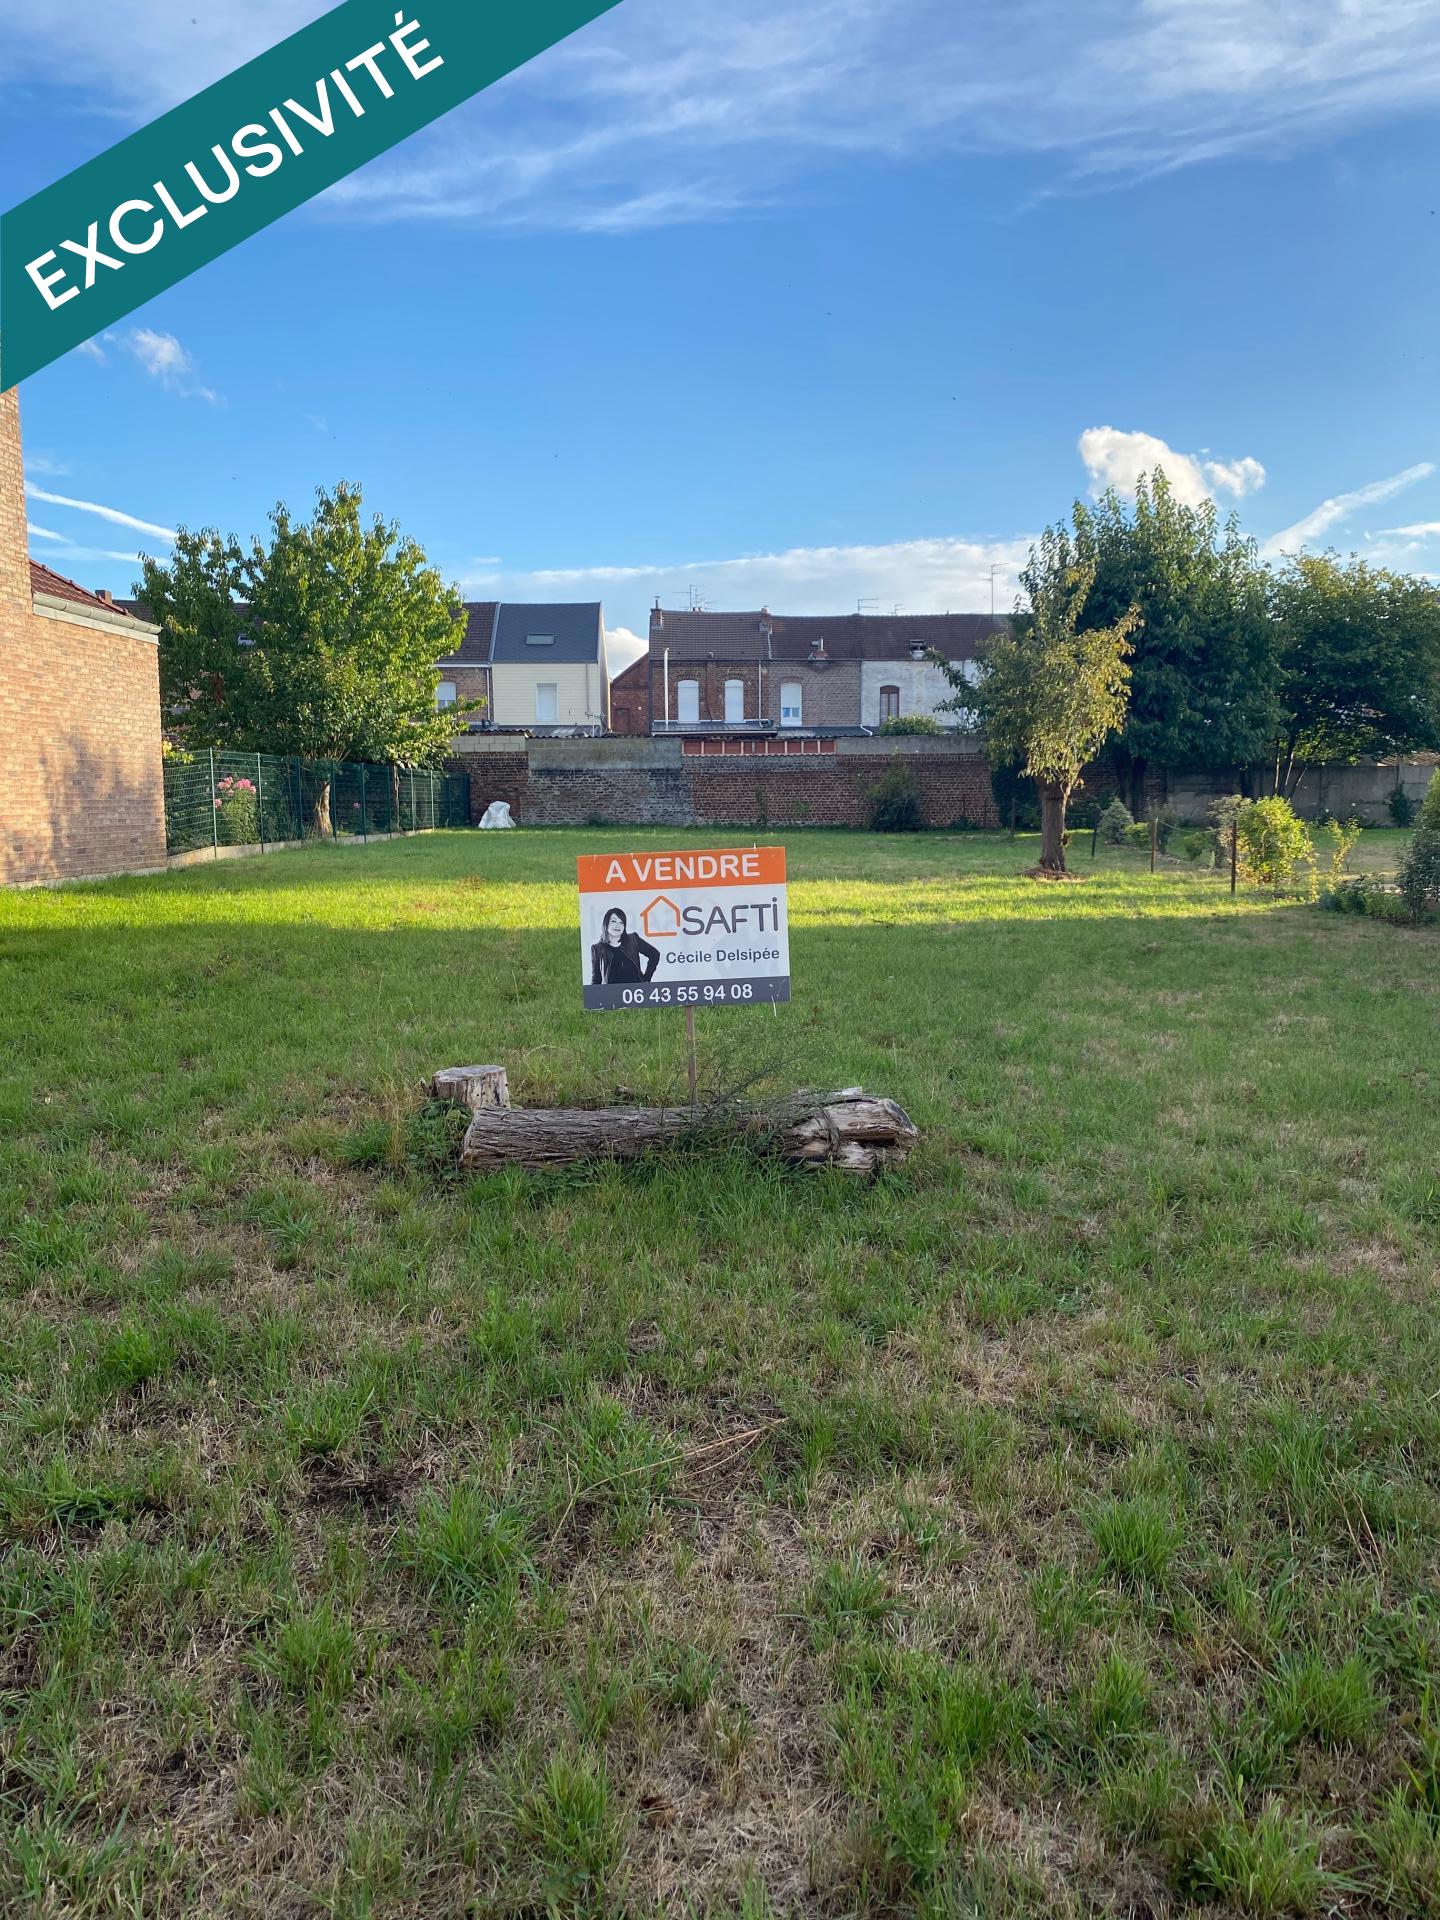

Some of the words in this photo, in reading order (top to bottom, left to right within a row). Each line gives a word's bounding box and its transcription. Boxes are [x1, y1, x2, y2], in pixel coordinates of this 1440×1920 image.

[605, 859, 627, 884] A
[632, 853, 761, 882] VENDRE
[666, 950, 712, 964] Cécile
[716, 947, 780, 963] Delsipée
[622, 988, 645, 1004] 06
[649, 987, 672, 1003] 43
[676, 986, 699, 1002] 55
[703, 985, 726, 1000] 94
[730, 984, 753, 999] 08
